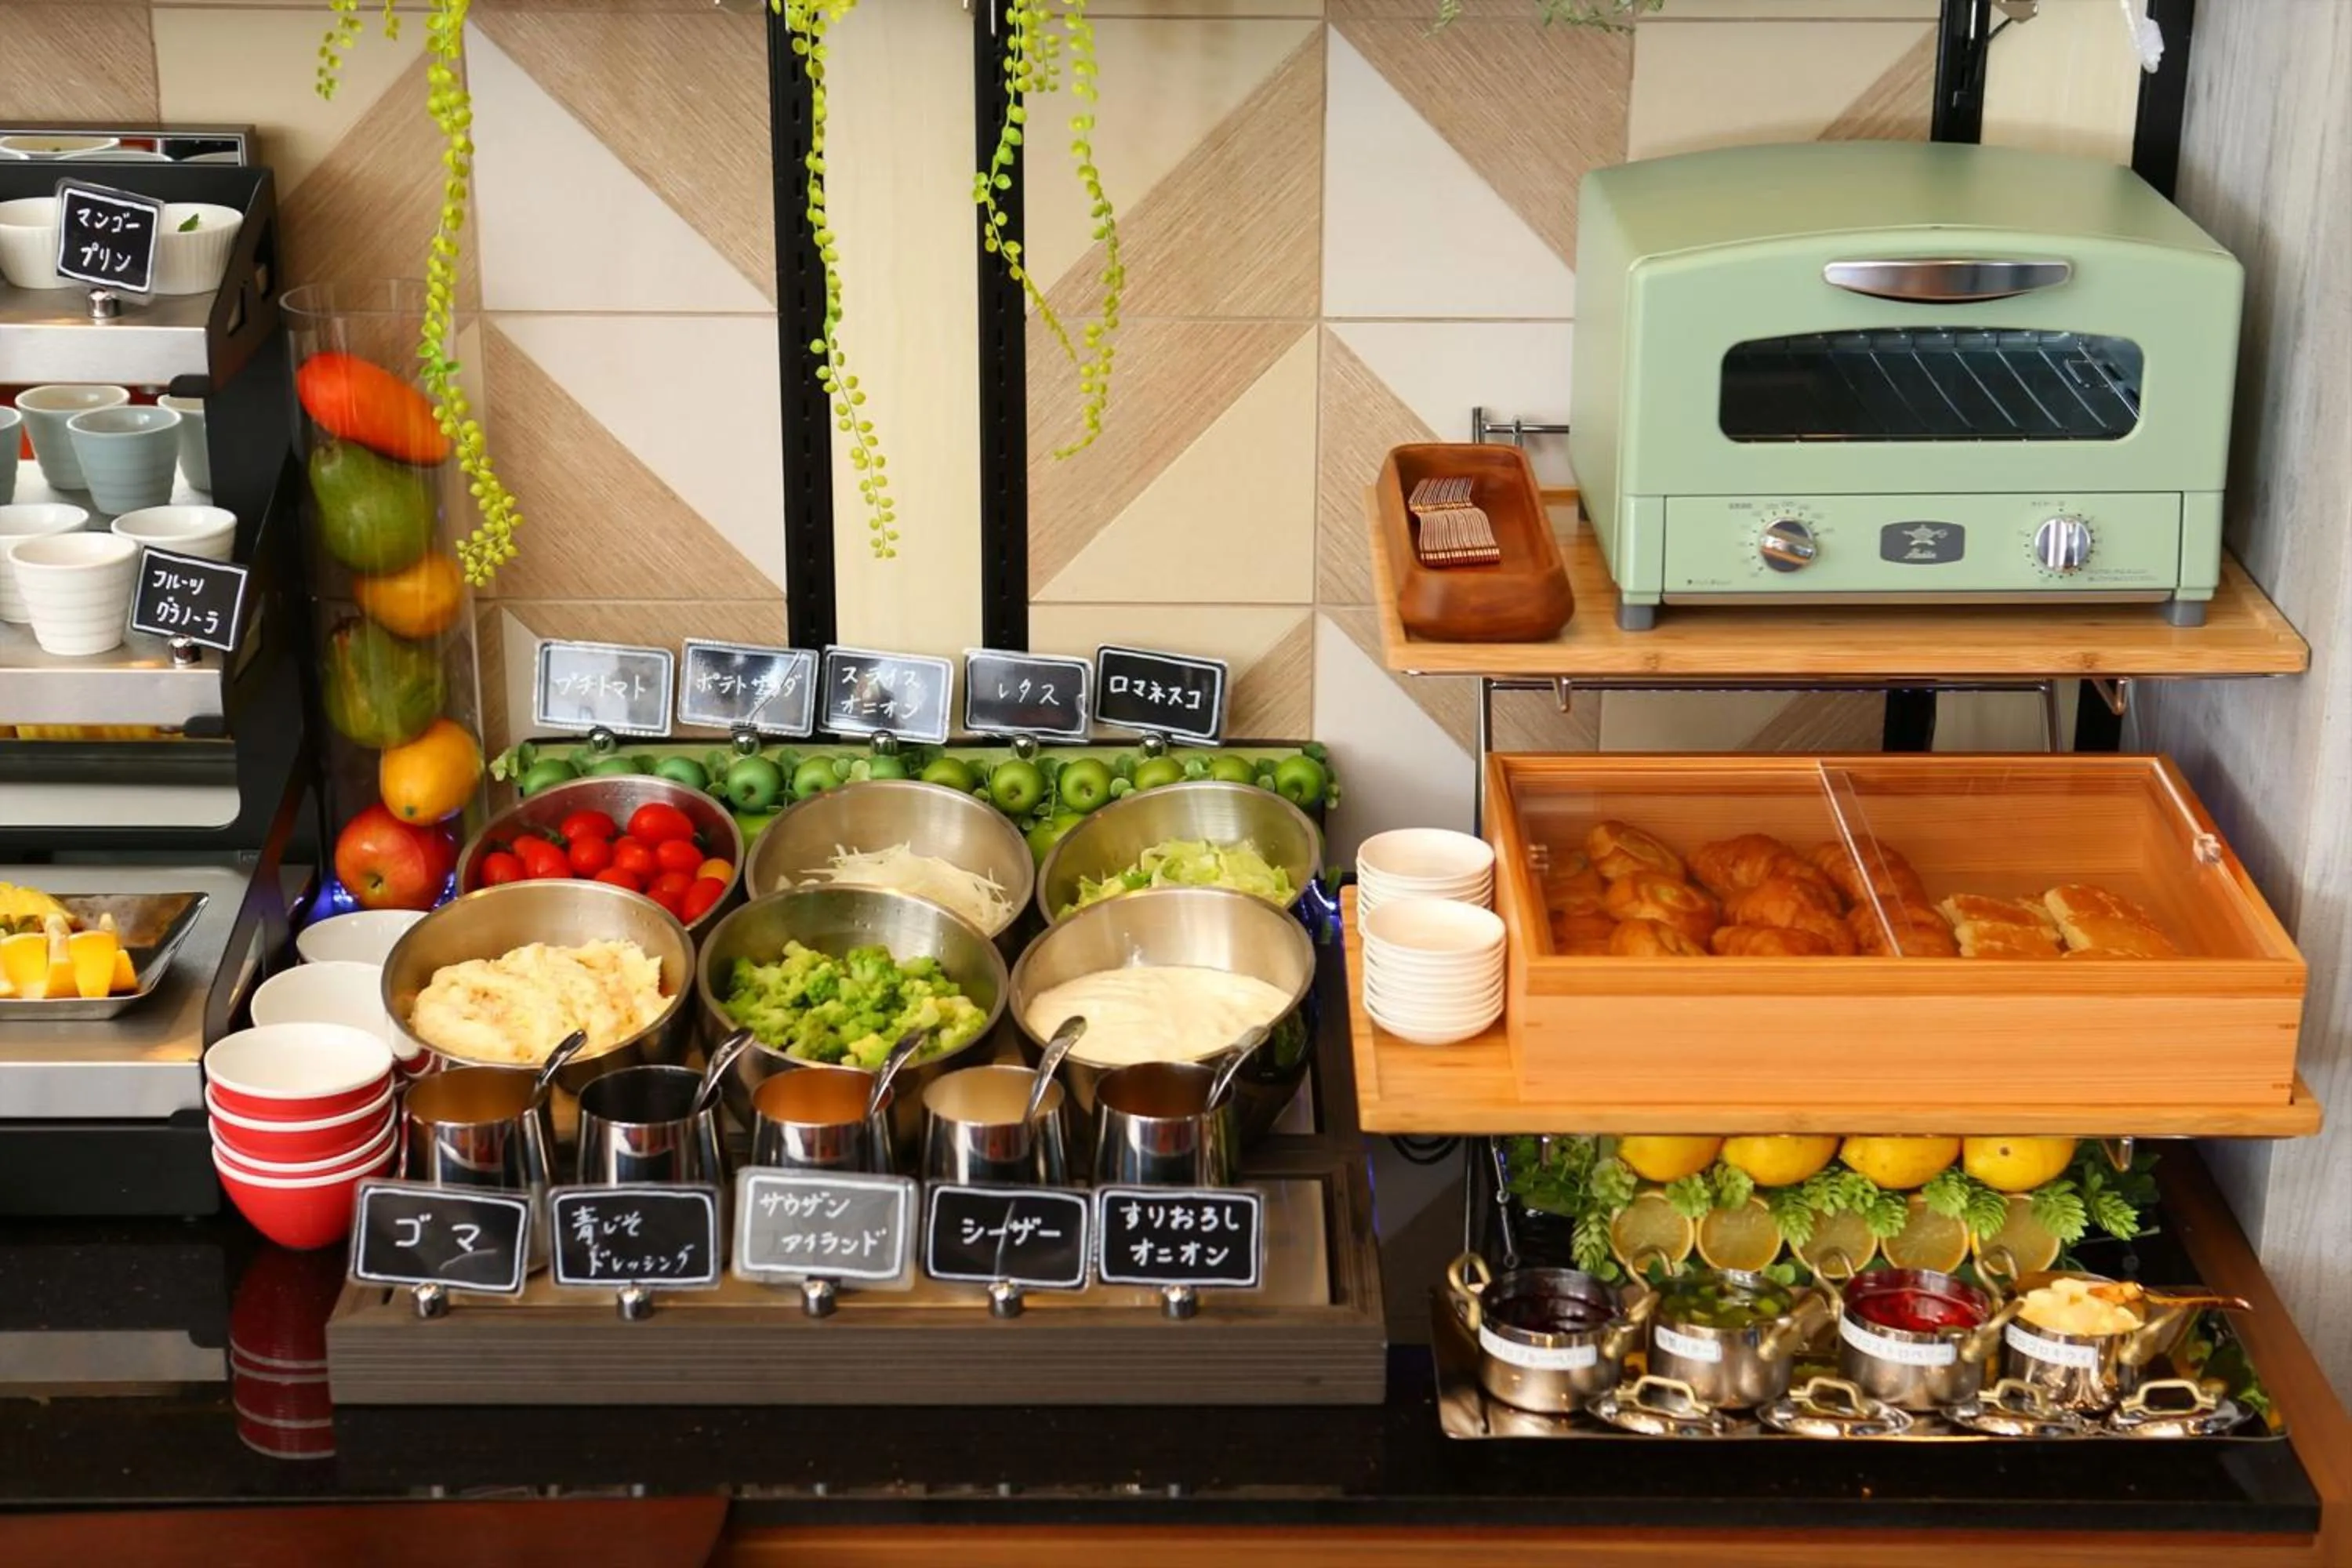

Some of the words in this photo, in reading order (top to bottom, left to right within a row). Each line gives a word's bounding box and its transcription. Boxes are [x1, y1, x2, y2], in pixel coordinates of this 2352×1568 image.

[77, 208, 140, 233] マンゴー
[80, 241, 132, 272] プリン
[153, 571, 205, 595] フルーツ
[157, 597, 219, 634] グラノーラ
[554, 673, 647, 700] プチトマト
[841, 666, 921, 688] スライス
[998, 678, 1060, 706] レタス
[840, 695, 920, 720] オニオン
[1109, 675, 1201, 710] ロマネスコ
[759, 1191, 851, 1218] サウザン
[1120, 1200, 1240, 1232] すりおろし
[394, 1213, 481, 1252] ゴマ
[571, 1205, 644, 1245] 青じそ
[961, 1218, 1061, 1246] シーザー
[782, 1227, 887, 1257] アイランド
[1130, 1236, 1229, 1267] オニオン
[589, 1243, 695, 1277] ドレッシング
